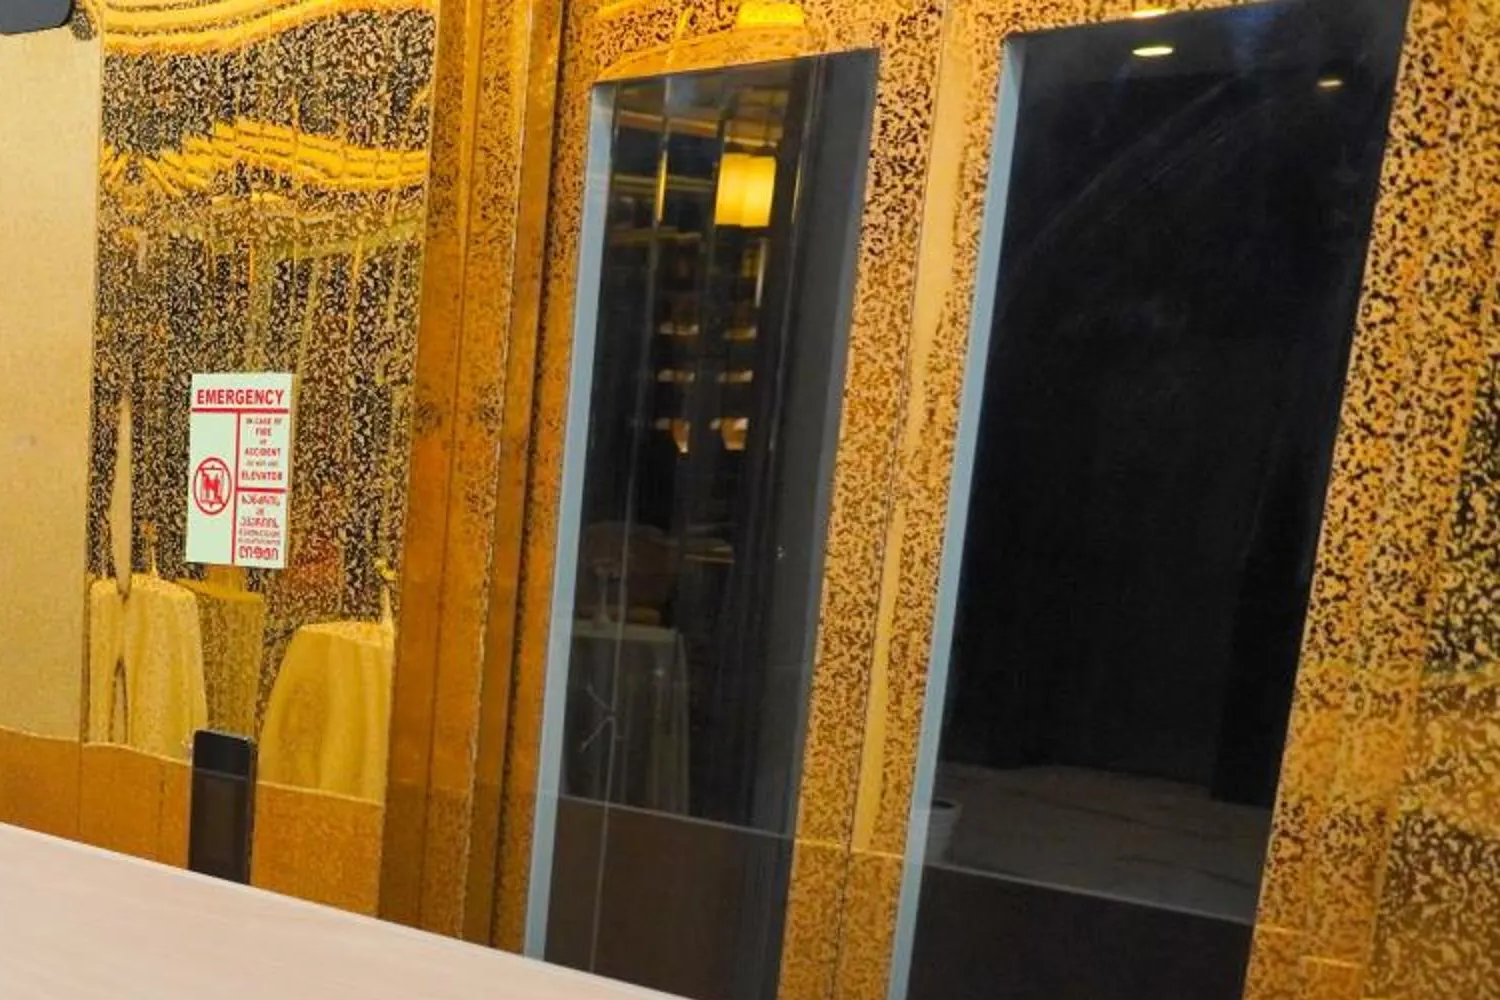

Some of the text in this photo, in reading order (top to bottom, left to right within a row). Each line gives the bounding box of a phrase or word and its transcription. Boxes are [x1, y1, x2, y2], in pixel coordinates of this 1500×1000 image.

[197, 389, 284, 405] EMERGENCY
[255, 428, 272, 436] FIRE
[244, 447, 281, 456] ACCIDENT
[241, 471, 283, 481] ELEVATOR
